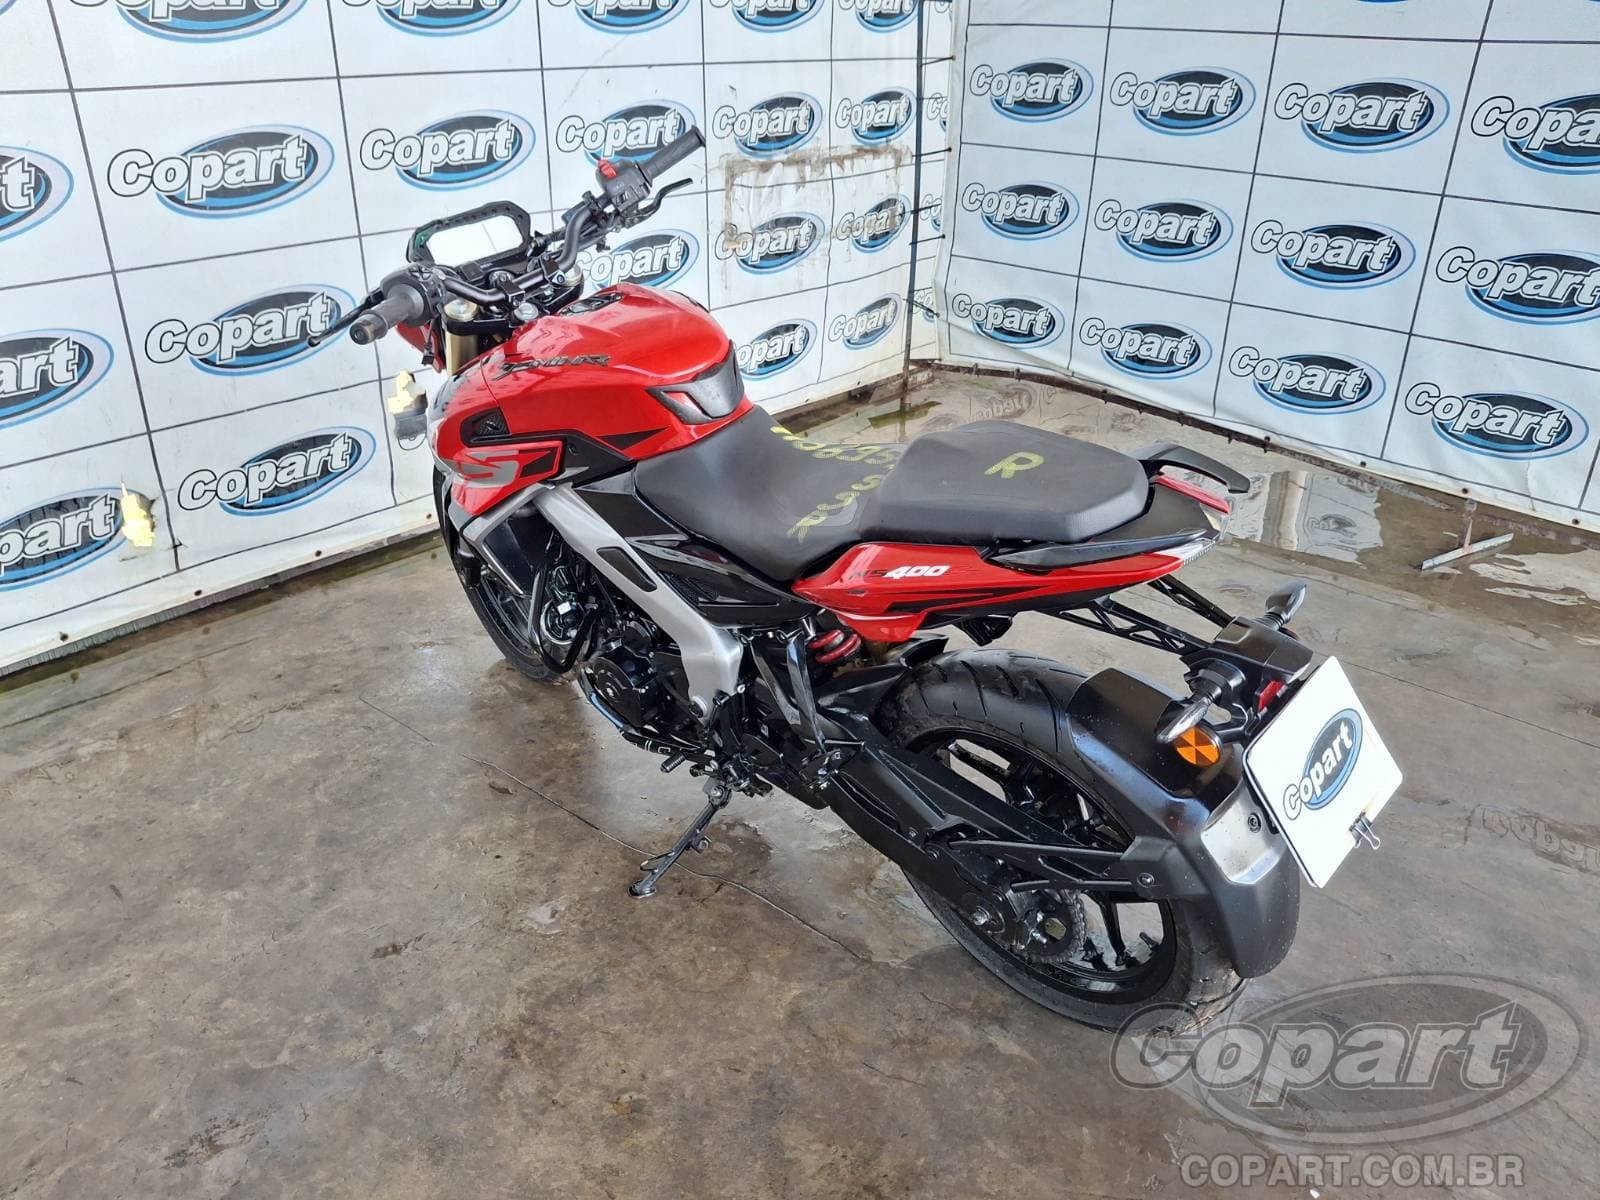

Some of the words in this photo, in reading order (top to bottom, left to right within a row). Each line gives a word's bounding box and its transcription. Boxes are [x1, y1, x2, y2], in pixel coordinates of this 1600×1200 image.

[970, 64, 1079, 108] Copart
[1110, 72, 1238, 119] Copart
[1274, 83, 1428, 134] Copart
[556, 108, 681, 157] Copart
[712, 100, 811, 145] Copart
[835, 95, 910, 133] Copart
[1471, 95, 1600, 152] Copa
[107, 134, 306, 203] Copart
[360, 119, 515, 176] Copart
[962, 183, 1065, 225] Copart
[1094, 200, 1216, 246] Copart
[715, 218, 814, 263] Copart
[1251, 220, 1396, 273] Copart
[1436, 246, 1600, 307] Copart
[145, 292, 331, 363] Copart
[828, 299, 897, 342] Copart
[952, 294, 1051, 337] Copart
[735, 322, 806, 373] opart
[1079, 318, 1196, 366] Copart
[1229, 346, 1366, 401] Copart
[1405, 382, 1566, 446] Copart
[178, 432, 352, 511] Copart
[0, 493, 116, 576] part
[1283, 720, 1354, 820] Copart
